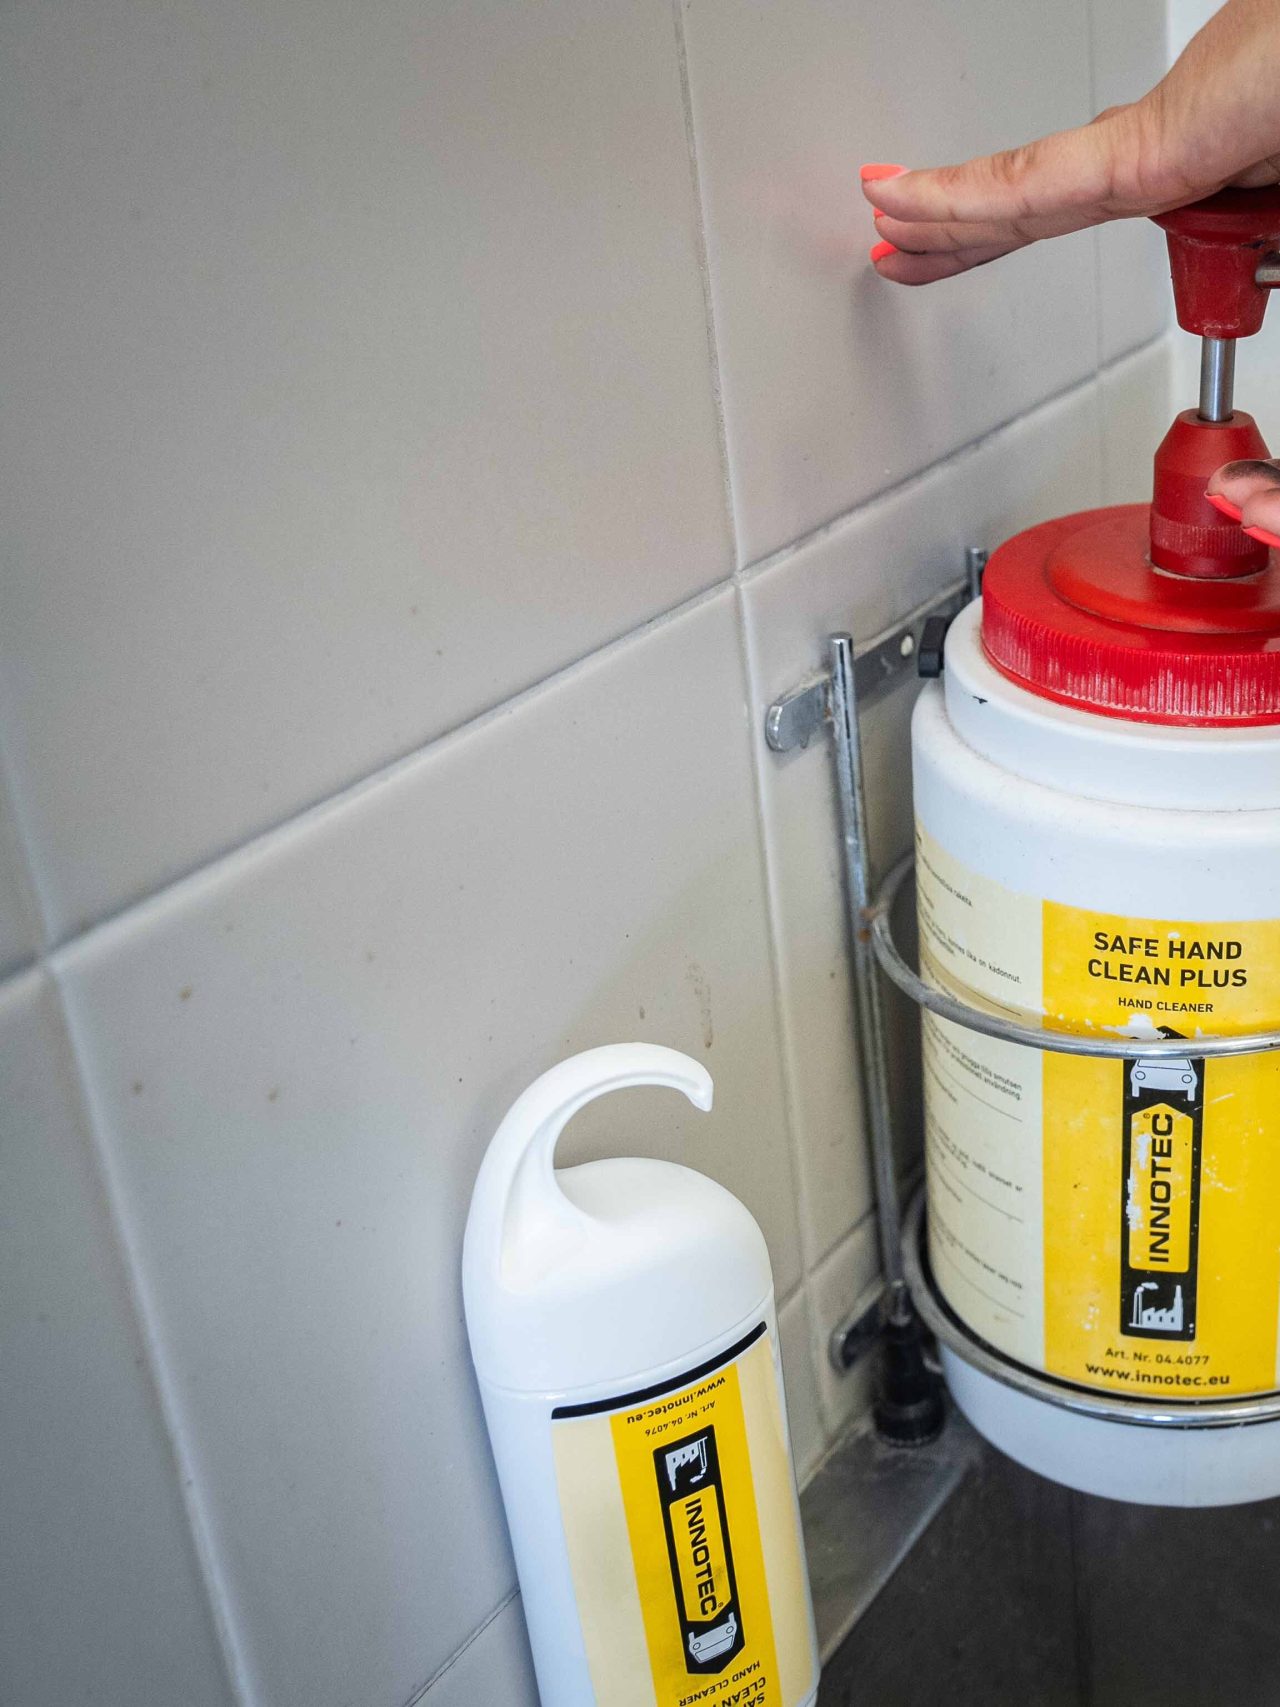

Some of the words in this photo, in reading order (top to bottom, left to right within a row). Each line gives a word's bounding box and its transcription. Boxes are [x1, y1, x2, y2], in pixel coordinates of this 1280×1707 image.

[1094, 932, 1159, 957] SAFE
[1168, 940, 1242, 960] HAND
[988, 961, 1022, 984] kadonnut.
[1088, 959, 1170, 986] CLEAN
[1180, 969, 1248, 987] PLUS
[1118, 997, 1152, 1009] HAND
[1156, 1001, 1214, 1013] CLEANER
[1149, 1113, 1173, 1263] INNOTEC
[1105, 1348, 1129, 1360] Art.
[1133, 1352, 1152, 1362] Nr.
[1156, 1354, 1210, 1365] 04.4077
[1085, 1363, 1230, 1386] www.innotec.eu
[627, 1377, 726, 1424] www.innotec.eu
[700, 1400, 716, 1413] Art.
[645, 1416, 683, 1437] 04.4076
[685, 1410, 698, 1420] Nr.
[685, 1498, 717, 1616] INNOTEC
[732, 1660, 760, 1682] HAND
[679, 1678, 729, 1707] CLEANER
